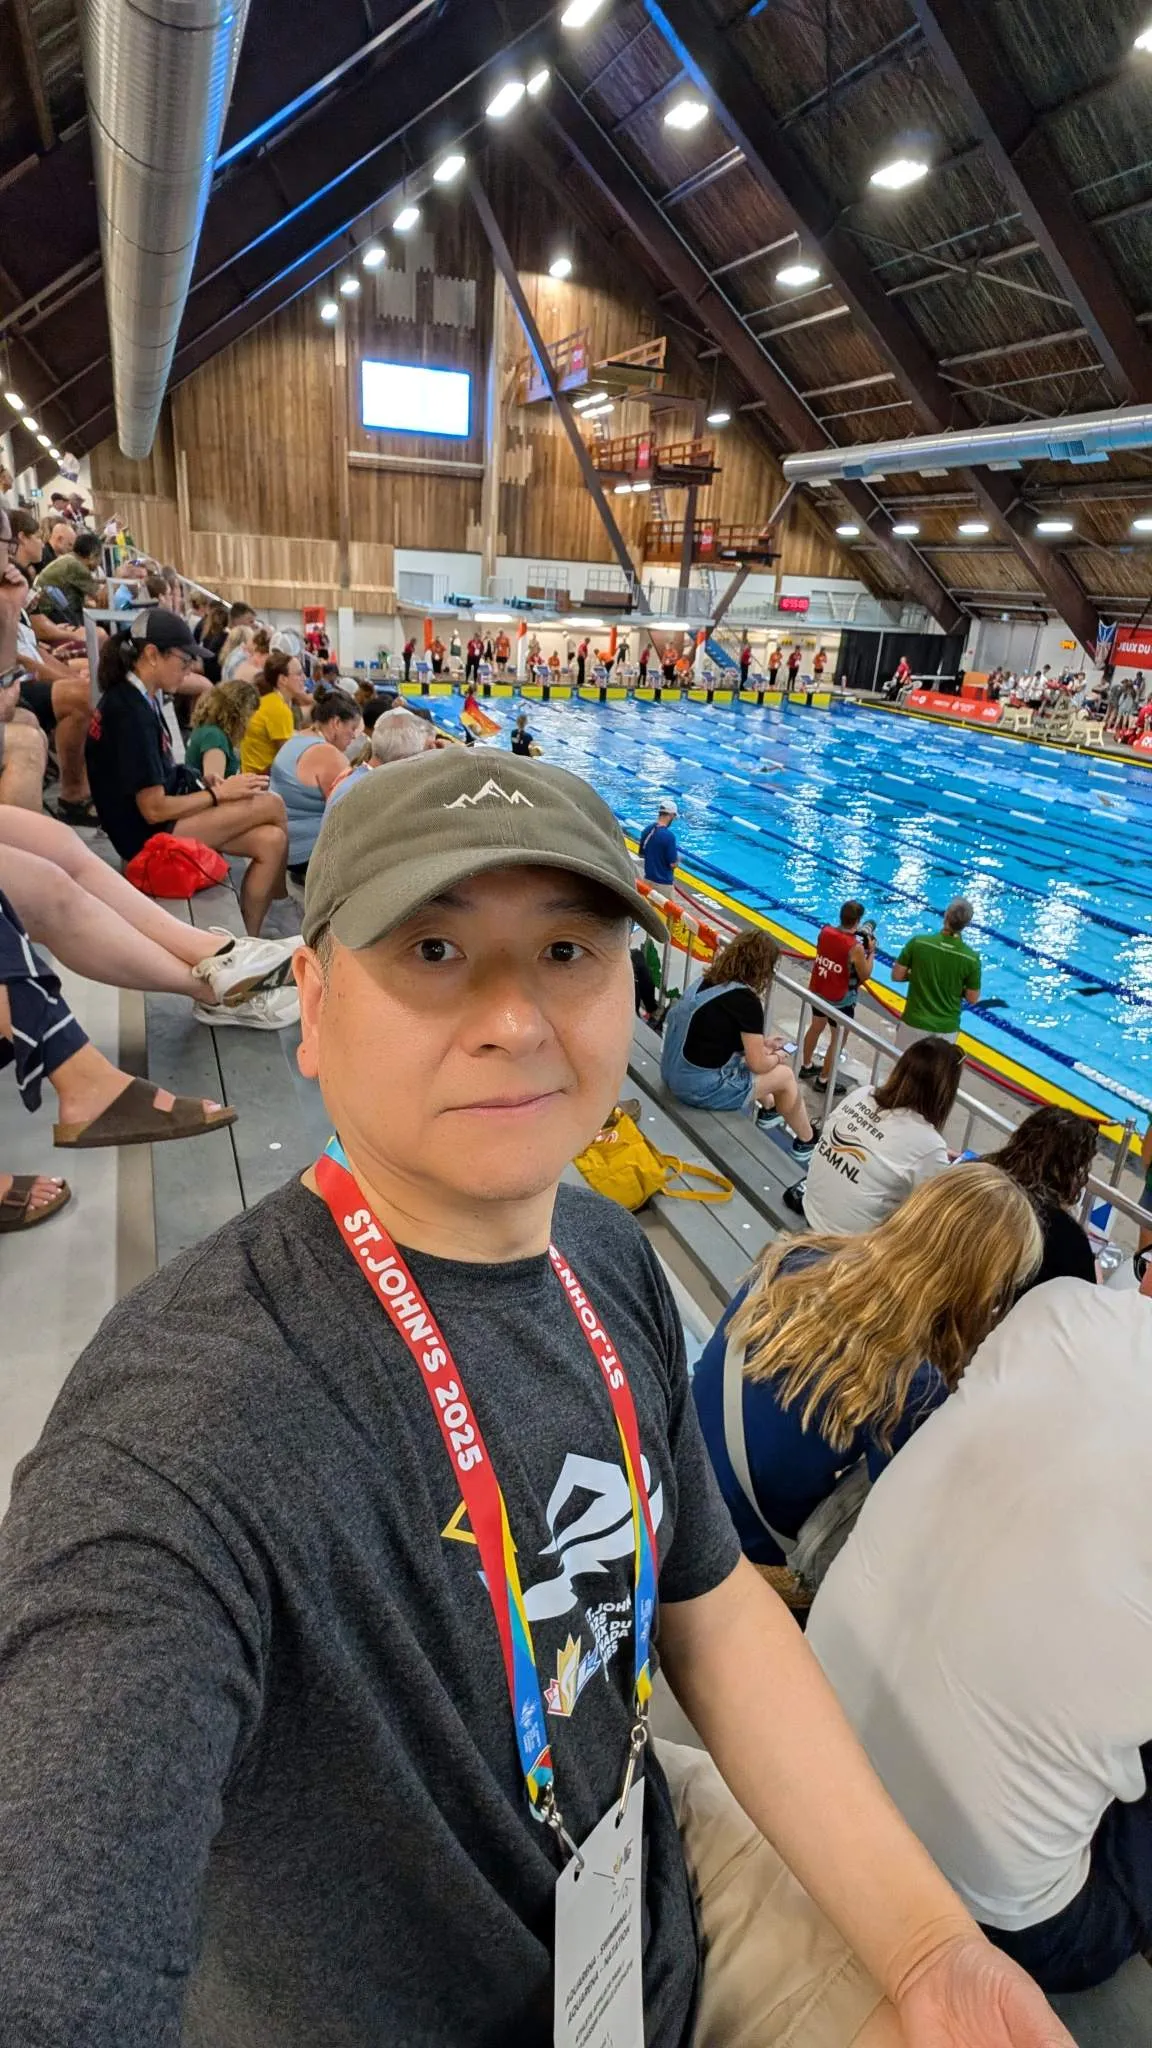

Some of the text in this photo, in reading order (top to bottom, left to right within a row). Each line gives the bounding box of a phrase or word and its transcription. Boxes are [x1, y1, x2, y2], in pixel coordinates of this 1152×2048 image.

[1117, 642, 1150, 655] JEUX DU
[816, 954, 843, 973] HOTO
[855, 1101, 882, 1124] PROUD
[846, 1122, 859, 1133] OF
[840, 1162, 860, 1185] NL
[434, 1380, 483, 1472] 2025
[609, 1620, 632, 1632] DU
[600, 1629, 629, 1652] NADA
